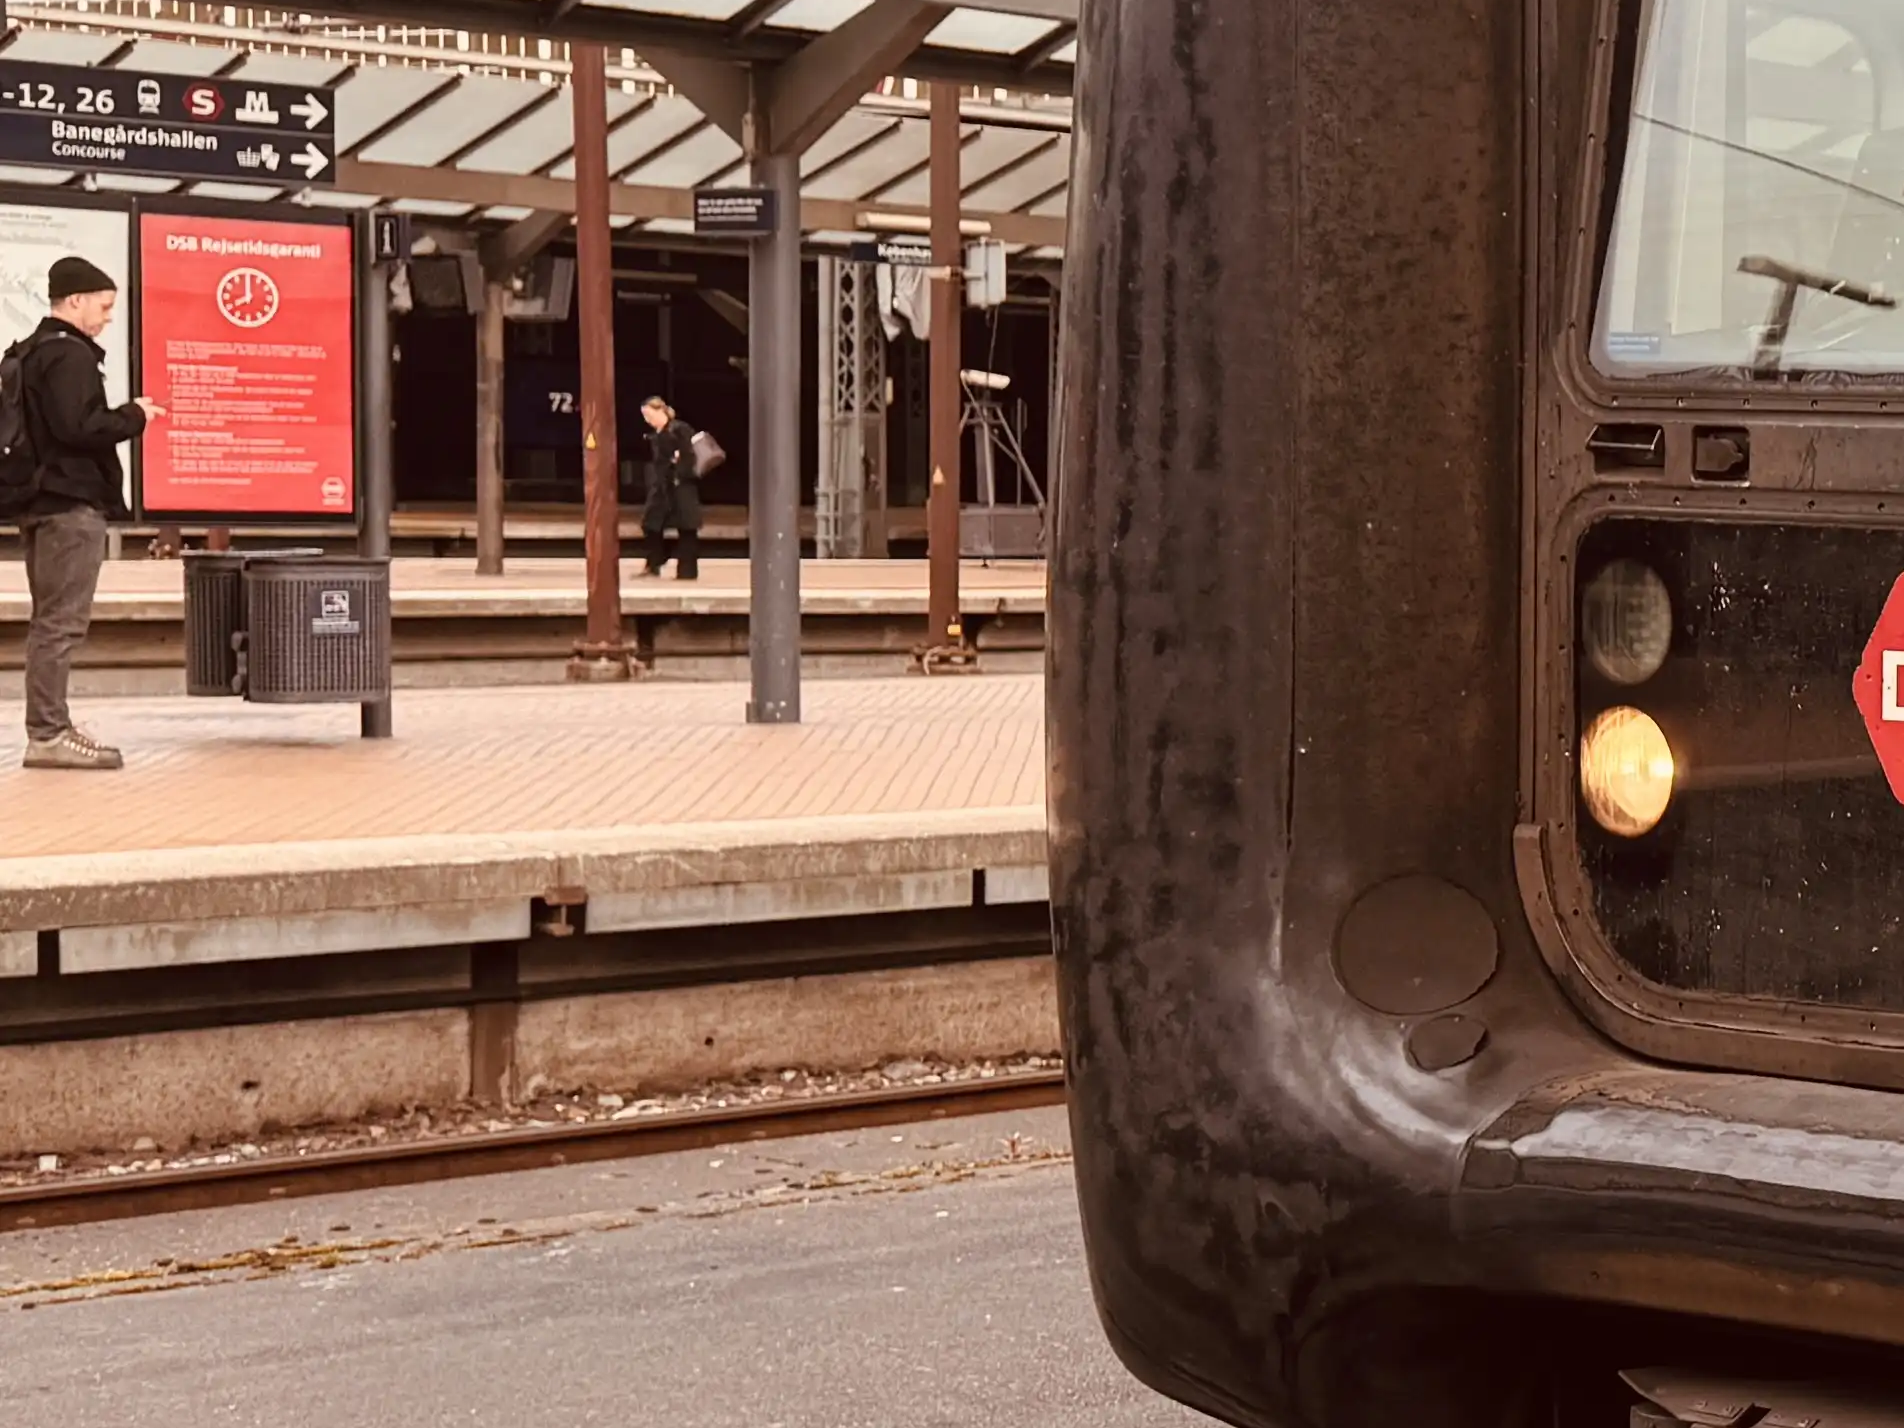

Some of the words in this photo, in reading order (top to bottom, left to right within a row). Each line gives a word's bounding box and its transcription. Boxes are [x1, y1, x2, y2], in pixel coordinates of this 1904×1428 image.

[76, 87, 115, 114] 26
[190, 89, 215, 116] S
[51, 120, 218, 151] Banegårdshallen
[51, 141, 126, 161] Concourse
[166, 234, 198, 251] DSB
